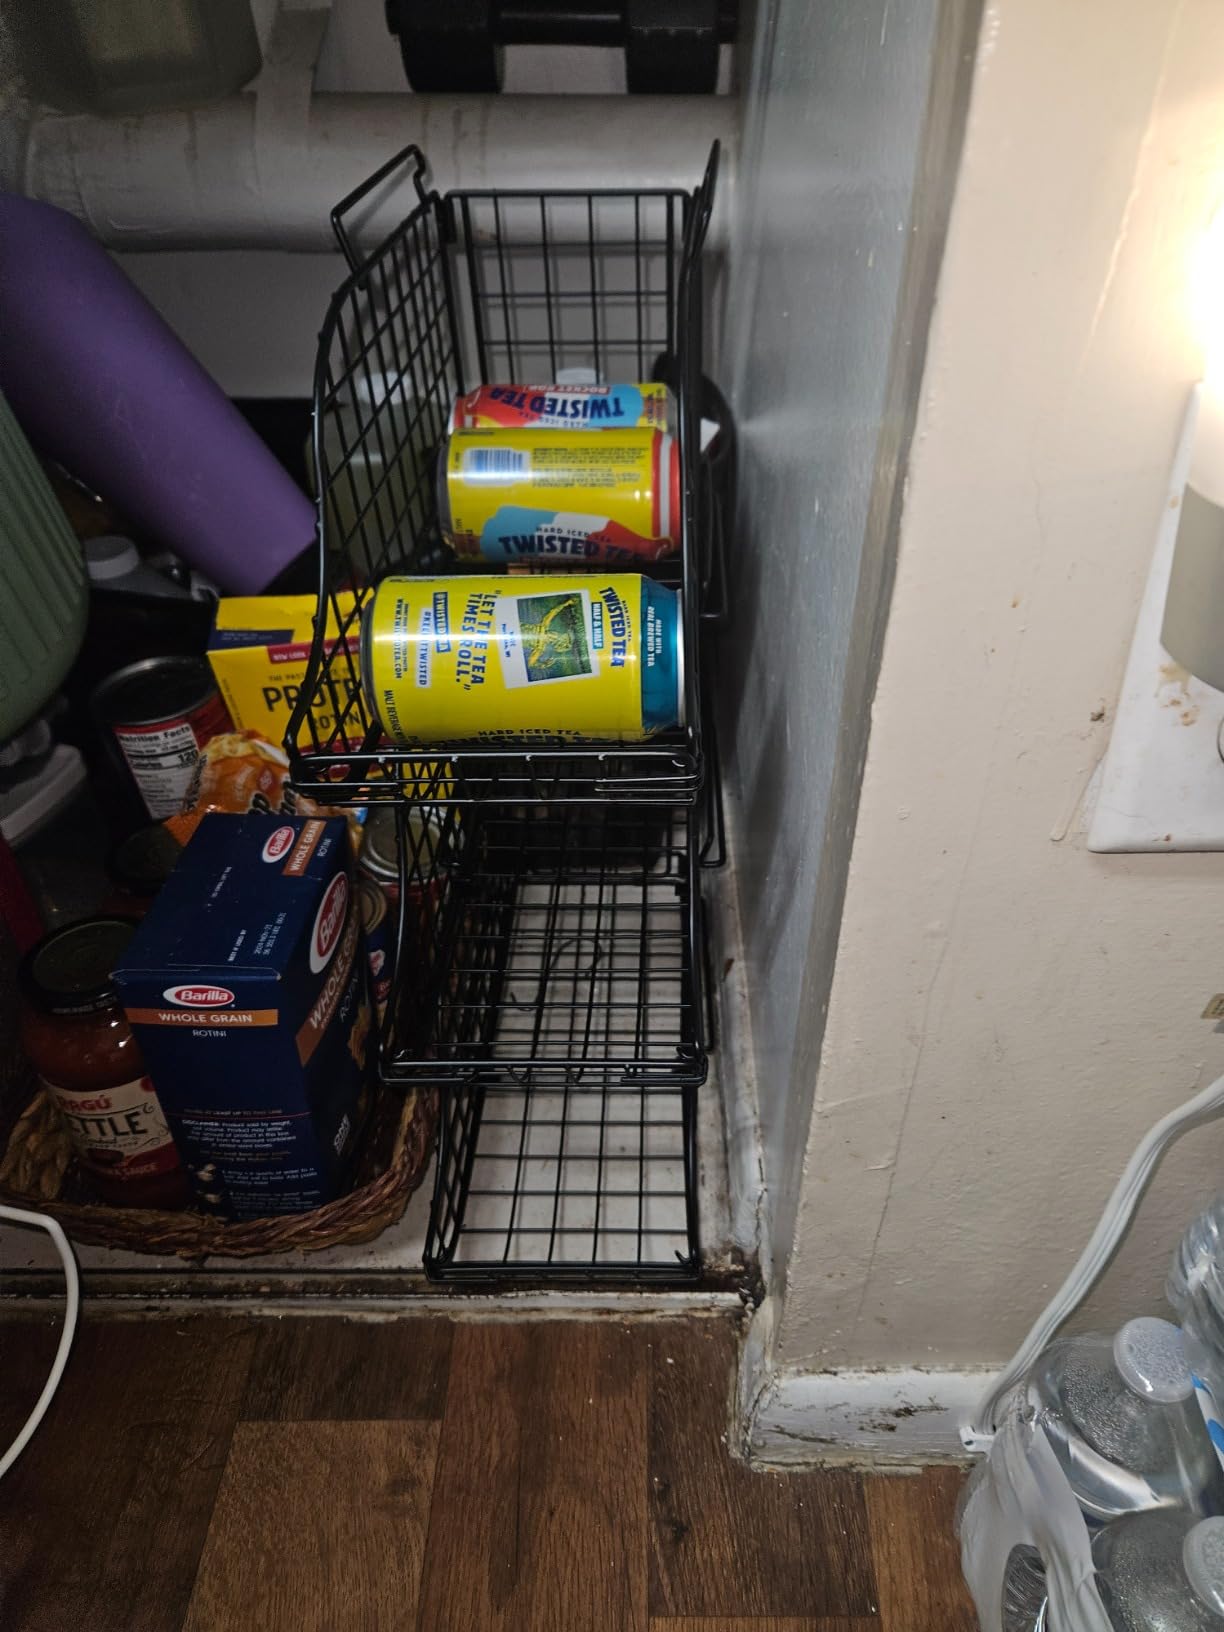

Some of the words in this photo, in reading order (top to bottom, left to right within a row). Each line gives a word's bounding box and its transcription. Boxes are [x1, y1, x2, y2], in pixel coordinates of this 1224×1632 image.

[489, 388, 525, 410] TEA
[558, 385, 608, 394] ROCKET
[530, 397, 624, 419] TWISTED
[536, 527, 563, 535] HARD
[566, 529, 589, 538] ICED
[498, 535, 600, 555] TWISTED
[461, 593, 483, 633] TIMES
[592, 603, 602, 620] HALF
[599, 587, 627, 637] TWISTED
[647, 606, 655, 622] REAL
[593, 628, 602, 648] HALF
[647, 623, 655, 653] BREWED
[610, 639, 627, 668] TEA
[647, 653, 655, 667] TEA
[471, 655, 487, 685] TEA
[384, 690, 396, 705] MALT
[119, 734, 161, 743] Nutrition
[163, 726, 190, 738] Facts
[270, 828, 292, 856] Barilla
[290, 843, 307, 872] WHOLE
[305, 821, 321, 845] GRAIN
[317, 838, 332, 857] ROTINI
[318, 879, 346, 950] Barilla
[180, 990, 229, 1002] Barilla
[311, 954, 345, 1029] WHOLE
[158, 1012, 207, 1023] WHOLE
[210, 1012, 253, 1023] GRAIN
[192, 1029, 227, 1038] ROTINI
